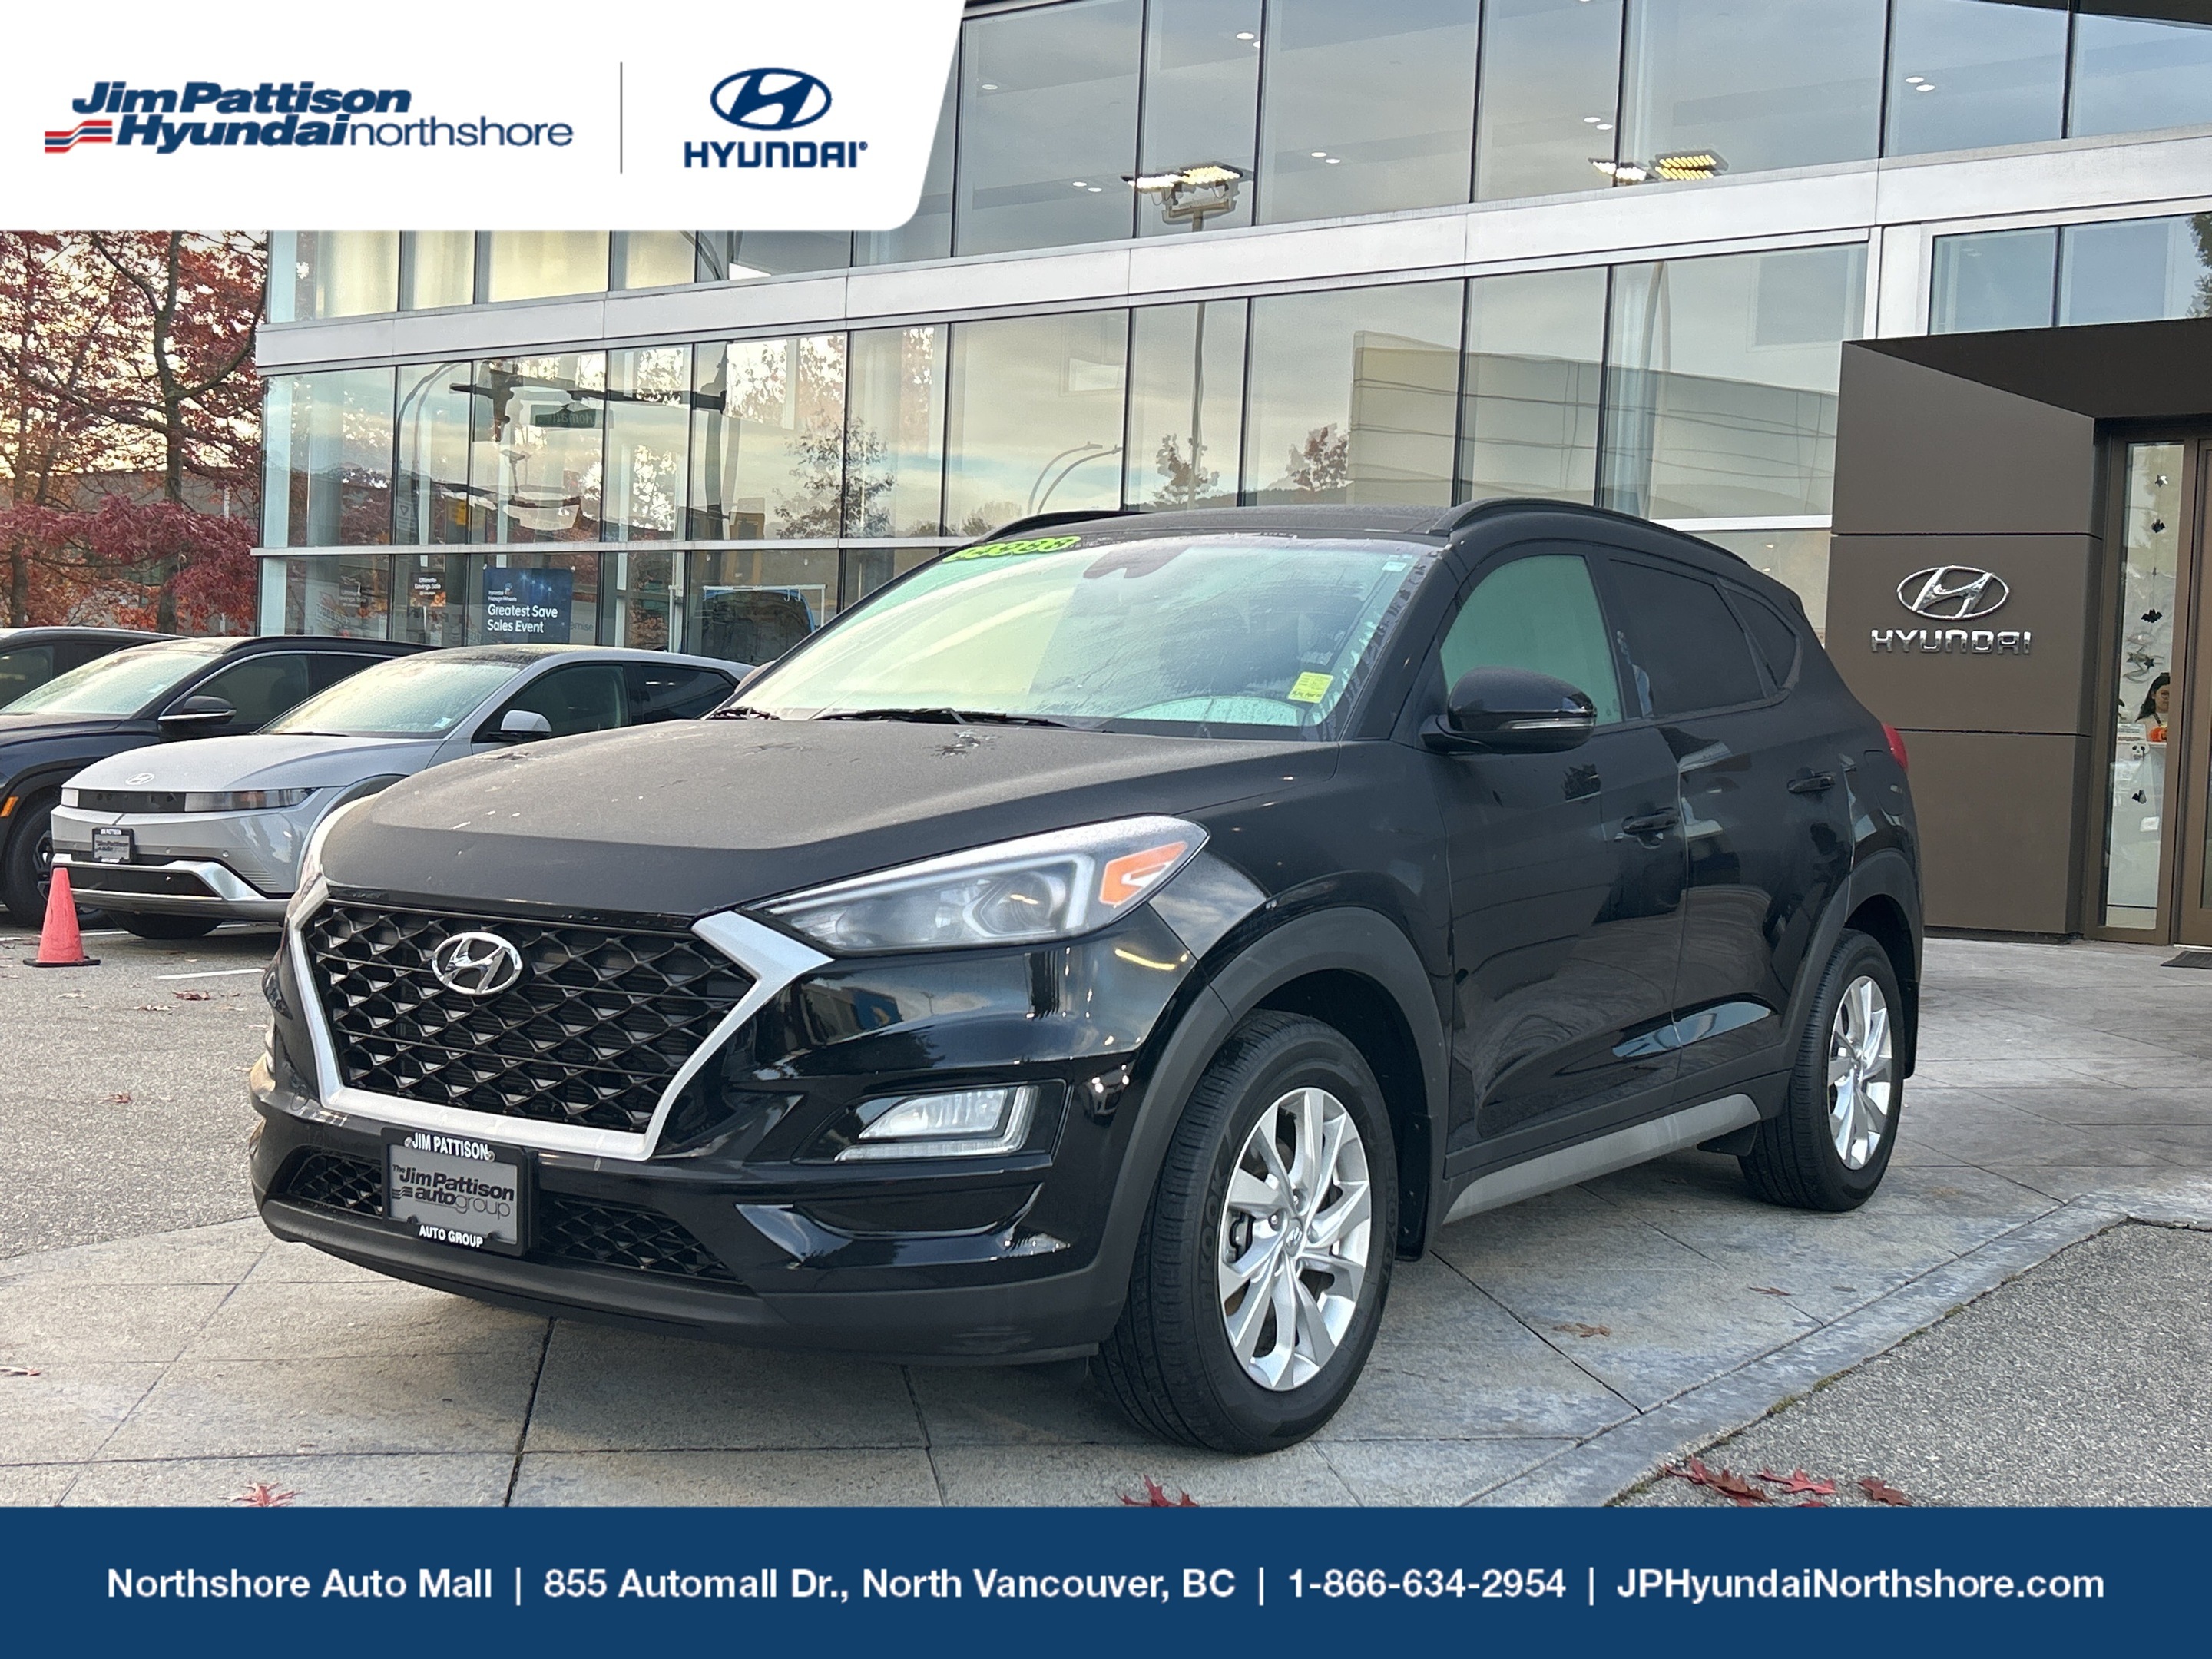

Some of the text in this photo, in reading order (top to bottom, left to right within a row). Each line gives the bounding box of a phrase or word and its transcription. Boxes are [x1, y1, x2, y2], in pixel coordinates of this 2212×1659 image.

[488, 604, 558, 618] Greatest Save
[487, 619, 545, 633] Sales Event
[1871, 629, 2032, 654] HYUNDAI
[412, 1132, 491, 1161] JIM PATTISON
[392, 1164, 406, 1174] The
[419, 1224, 484, 1248] AUTO GROUP
